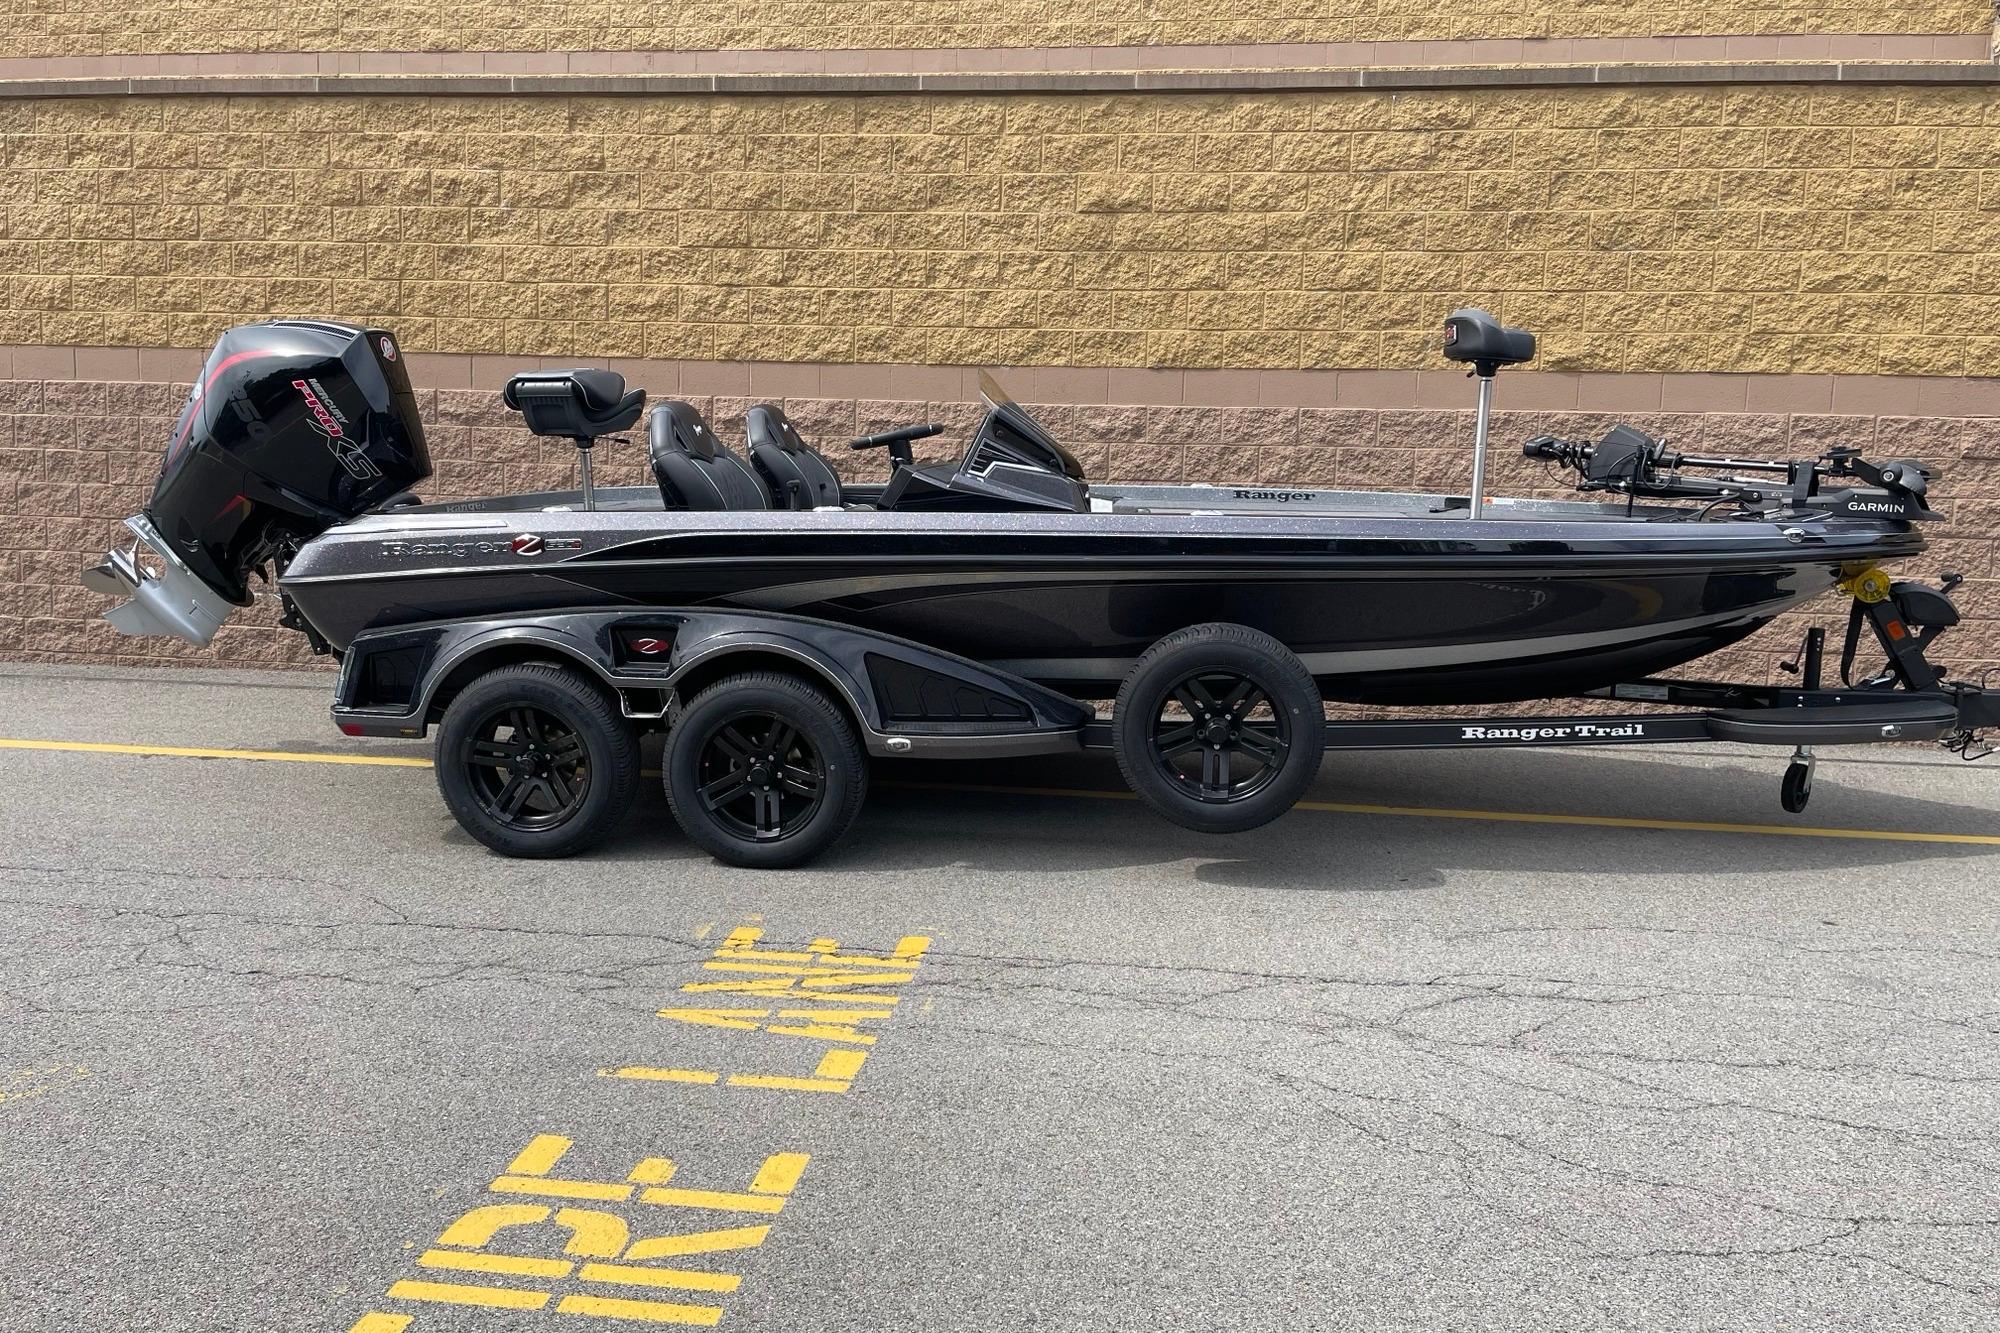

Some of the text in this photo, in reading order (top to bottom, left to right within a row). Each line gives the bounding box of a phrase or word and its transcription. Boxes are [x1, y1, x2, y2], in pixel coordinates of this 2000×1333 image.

[292, 379, 344, 437] PRO
[308, 378, 350, 424] MERCURY
[305, 418, 383, 480] XS
[1232, 489, 1316, 503] Ranger
[444, 500, 487, 513] Ranger
[1848, 502, 1905, 513] GARMIN
[381, 541, 513, 557] Ranger
[1461, 724, 1645, 741] Ranger Trail
[348, 926, 933, 1333] IRE LANE
